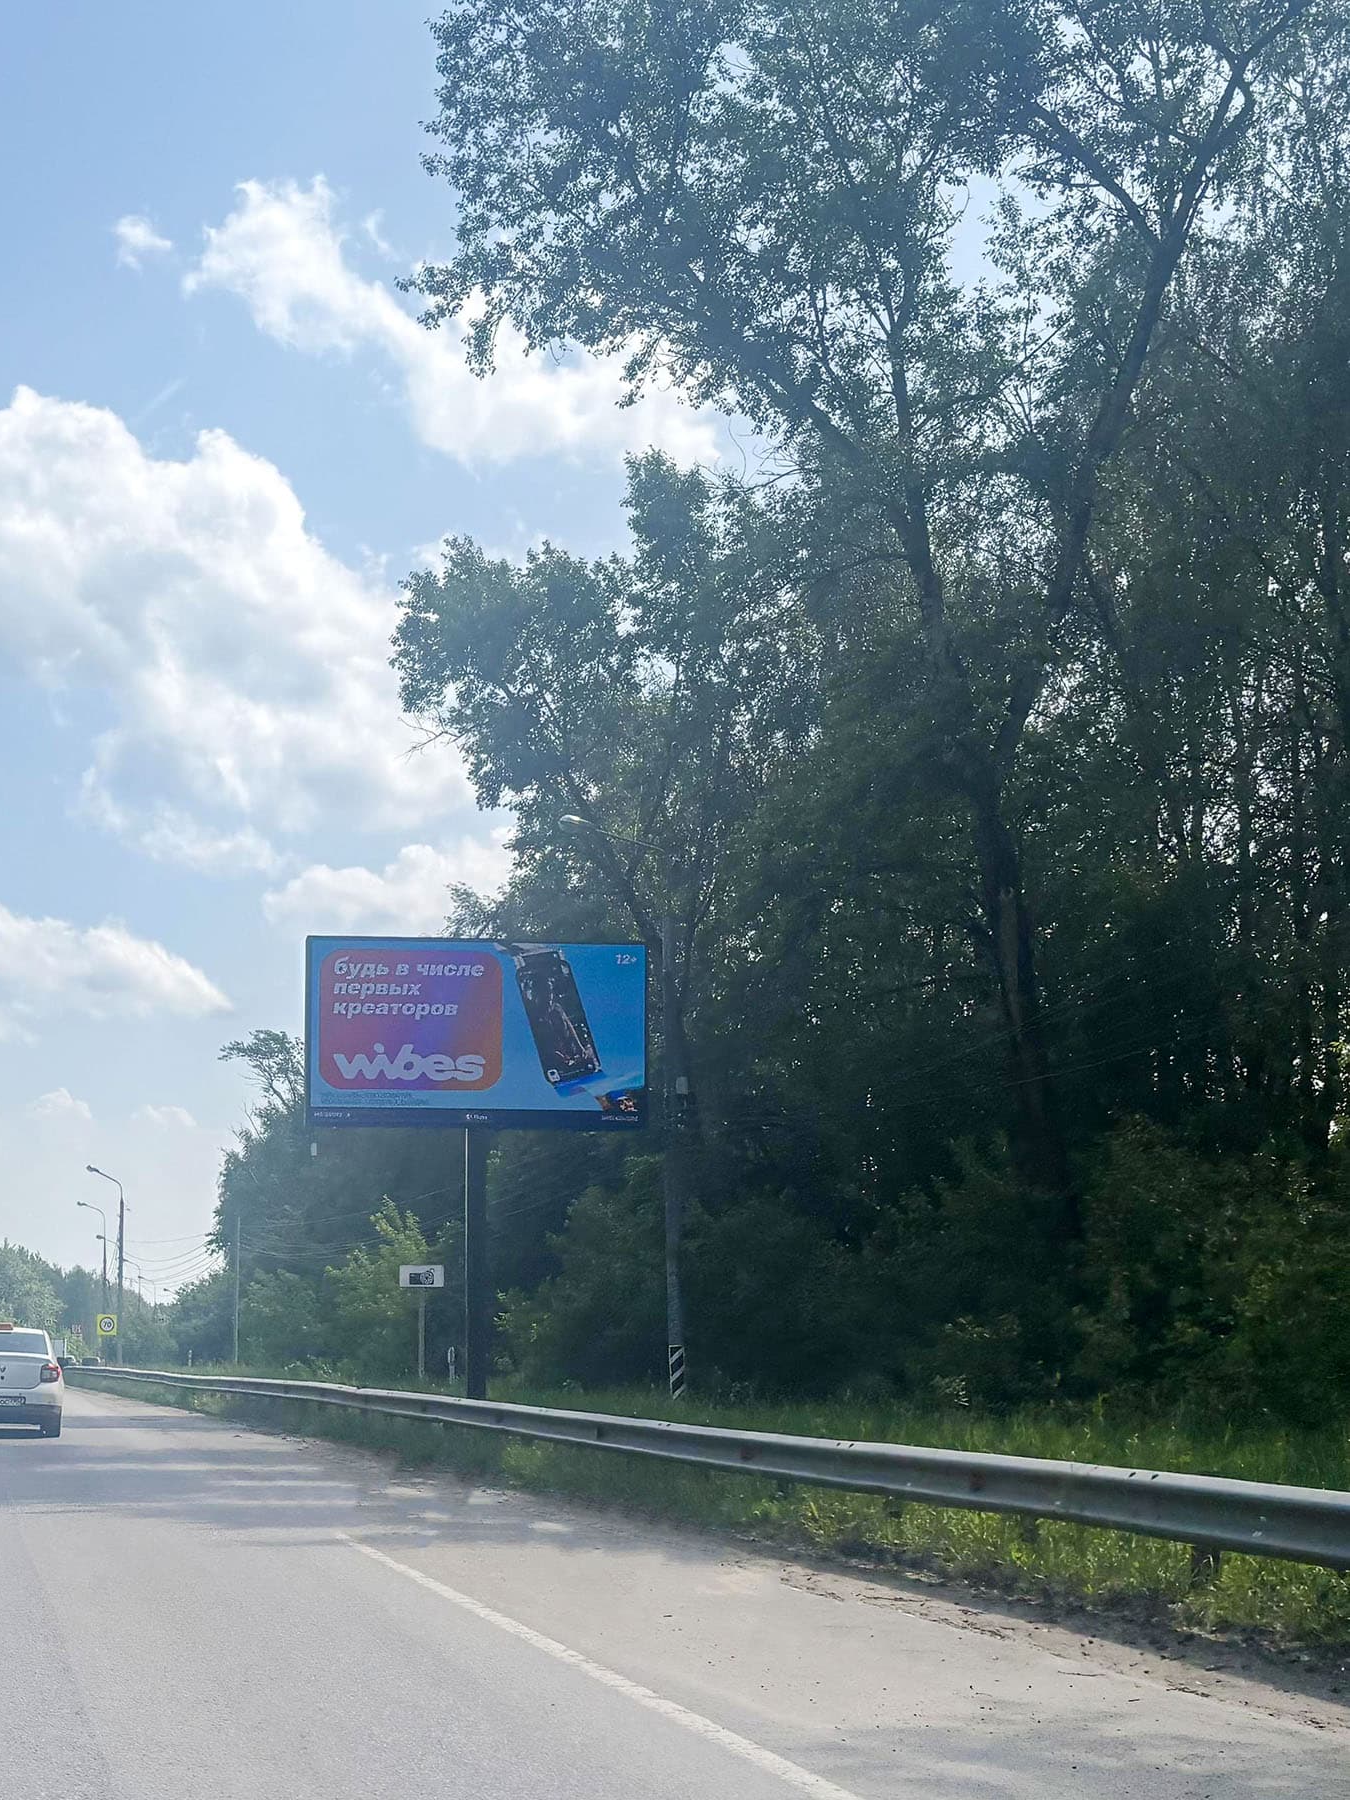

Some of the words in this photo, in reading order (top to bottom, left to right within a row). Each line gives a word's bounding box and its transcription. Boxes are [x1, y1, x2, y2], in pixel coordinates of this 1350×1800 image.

[333, 956, 390, 979] будь
[395, 963, 410, 976] в
[416, 962, 486, 977] числе
[615, 953, 638, 965] 12+
[333, 981, 422, 999] первых
[333, 1002, 459, 1020] креаторов
[333, 1042, 486, 1081] wibes
[103, 1320, 112, 1328] 70
